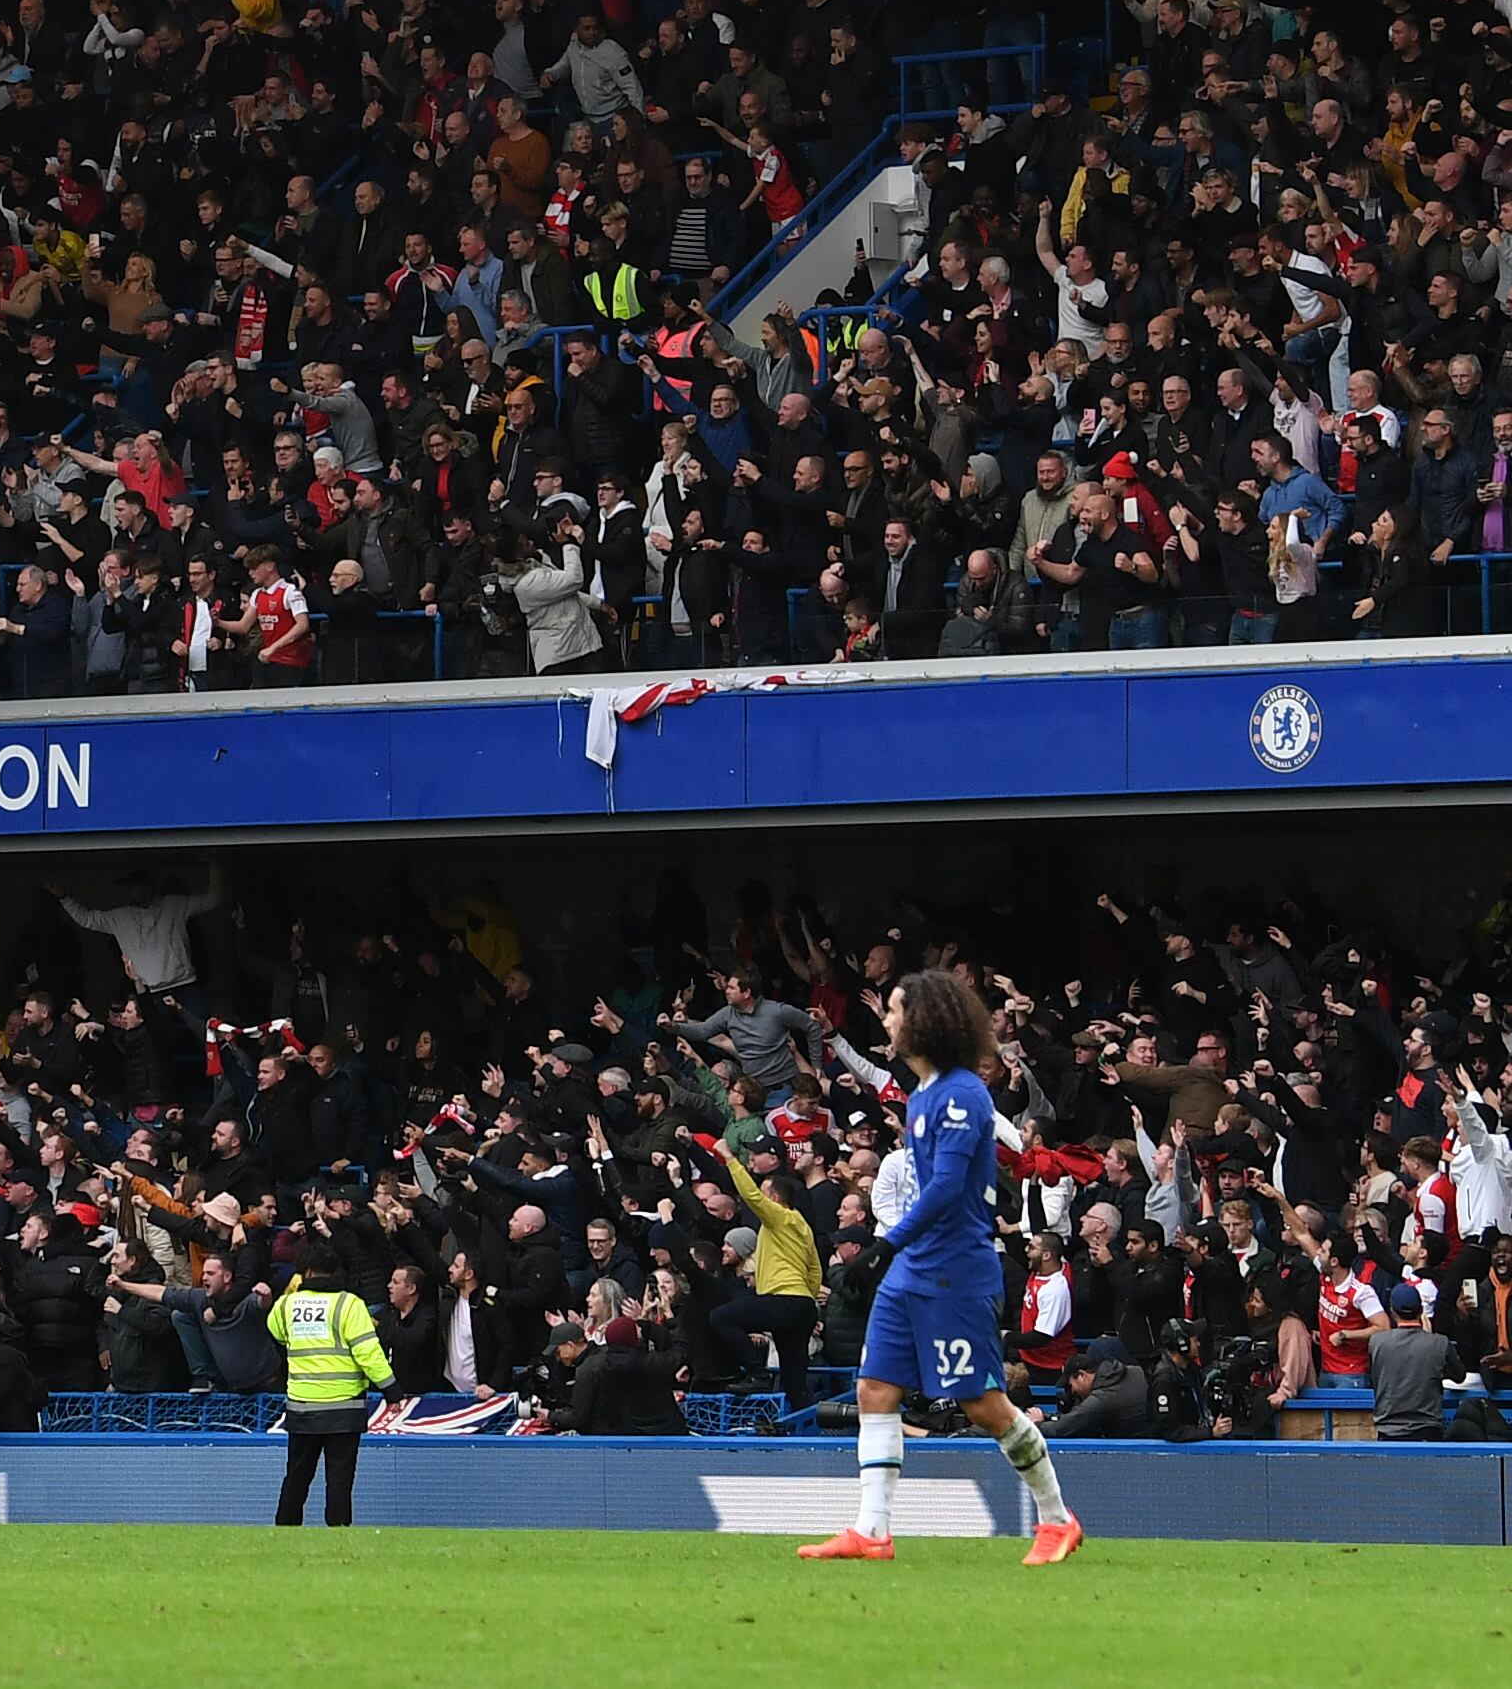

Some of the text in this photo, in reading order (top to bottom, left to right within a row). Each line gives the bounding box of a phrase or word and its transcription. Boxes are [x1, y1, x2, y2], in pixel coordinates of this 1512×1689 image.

[1262, 687, 1310, 708] CHELSEA
[292, 1307, 326, 1322] 262
[933, 1338, 975, 1376] 32
